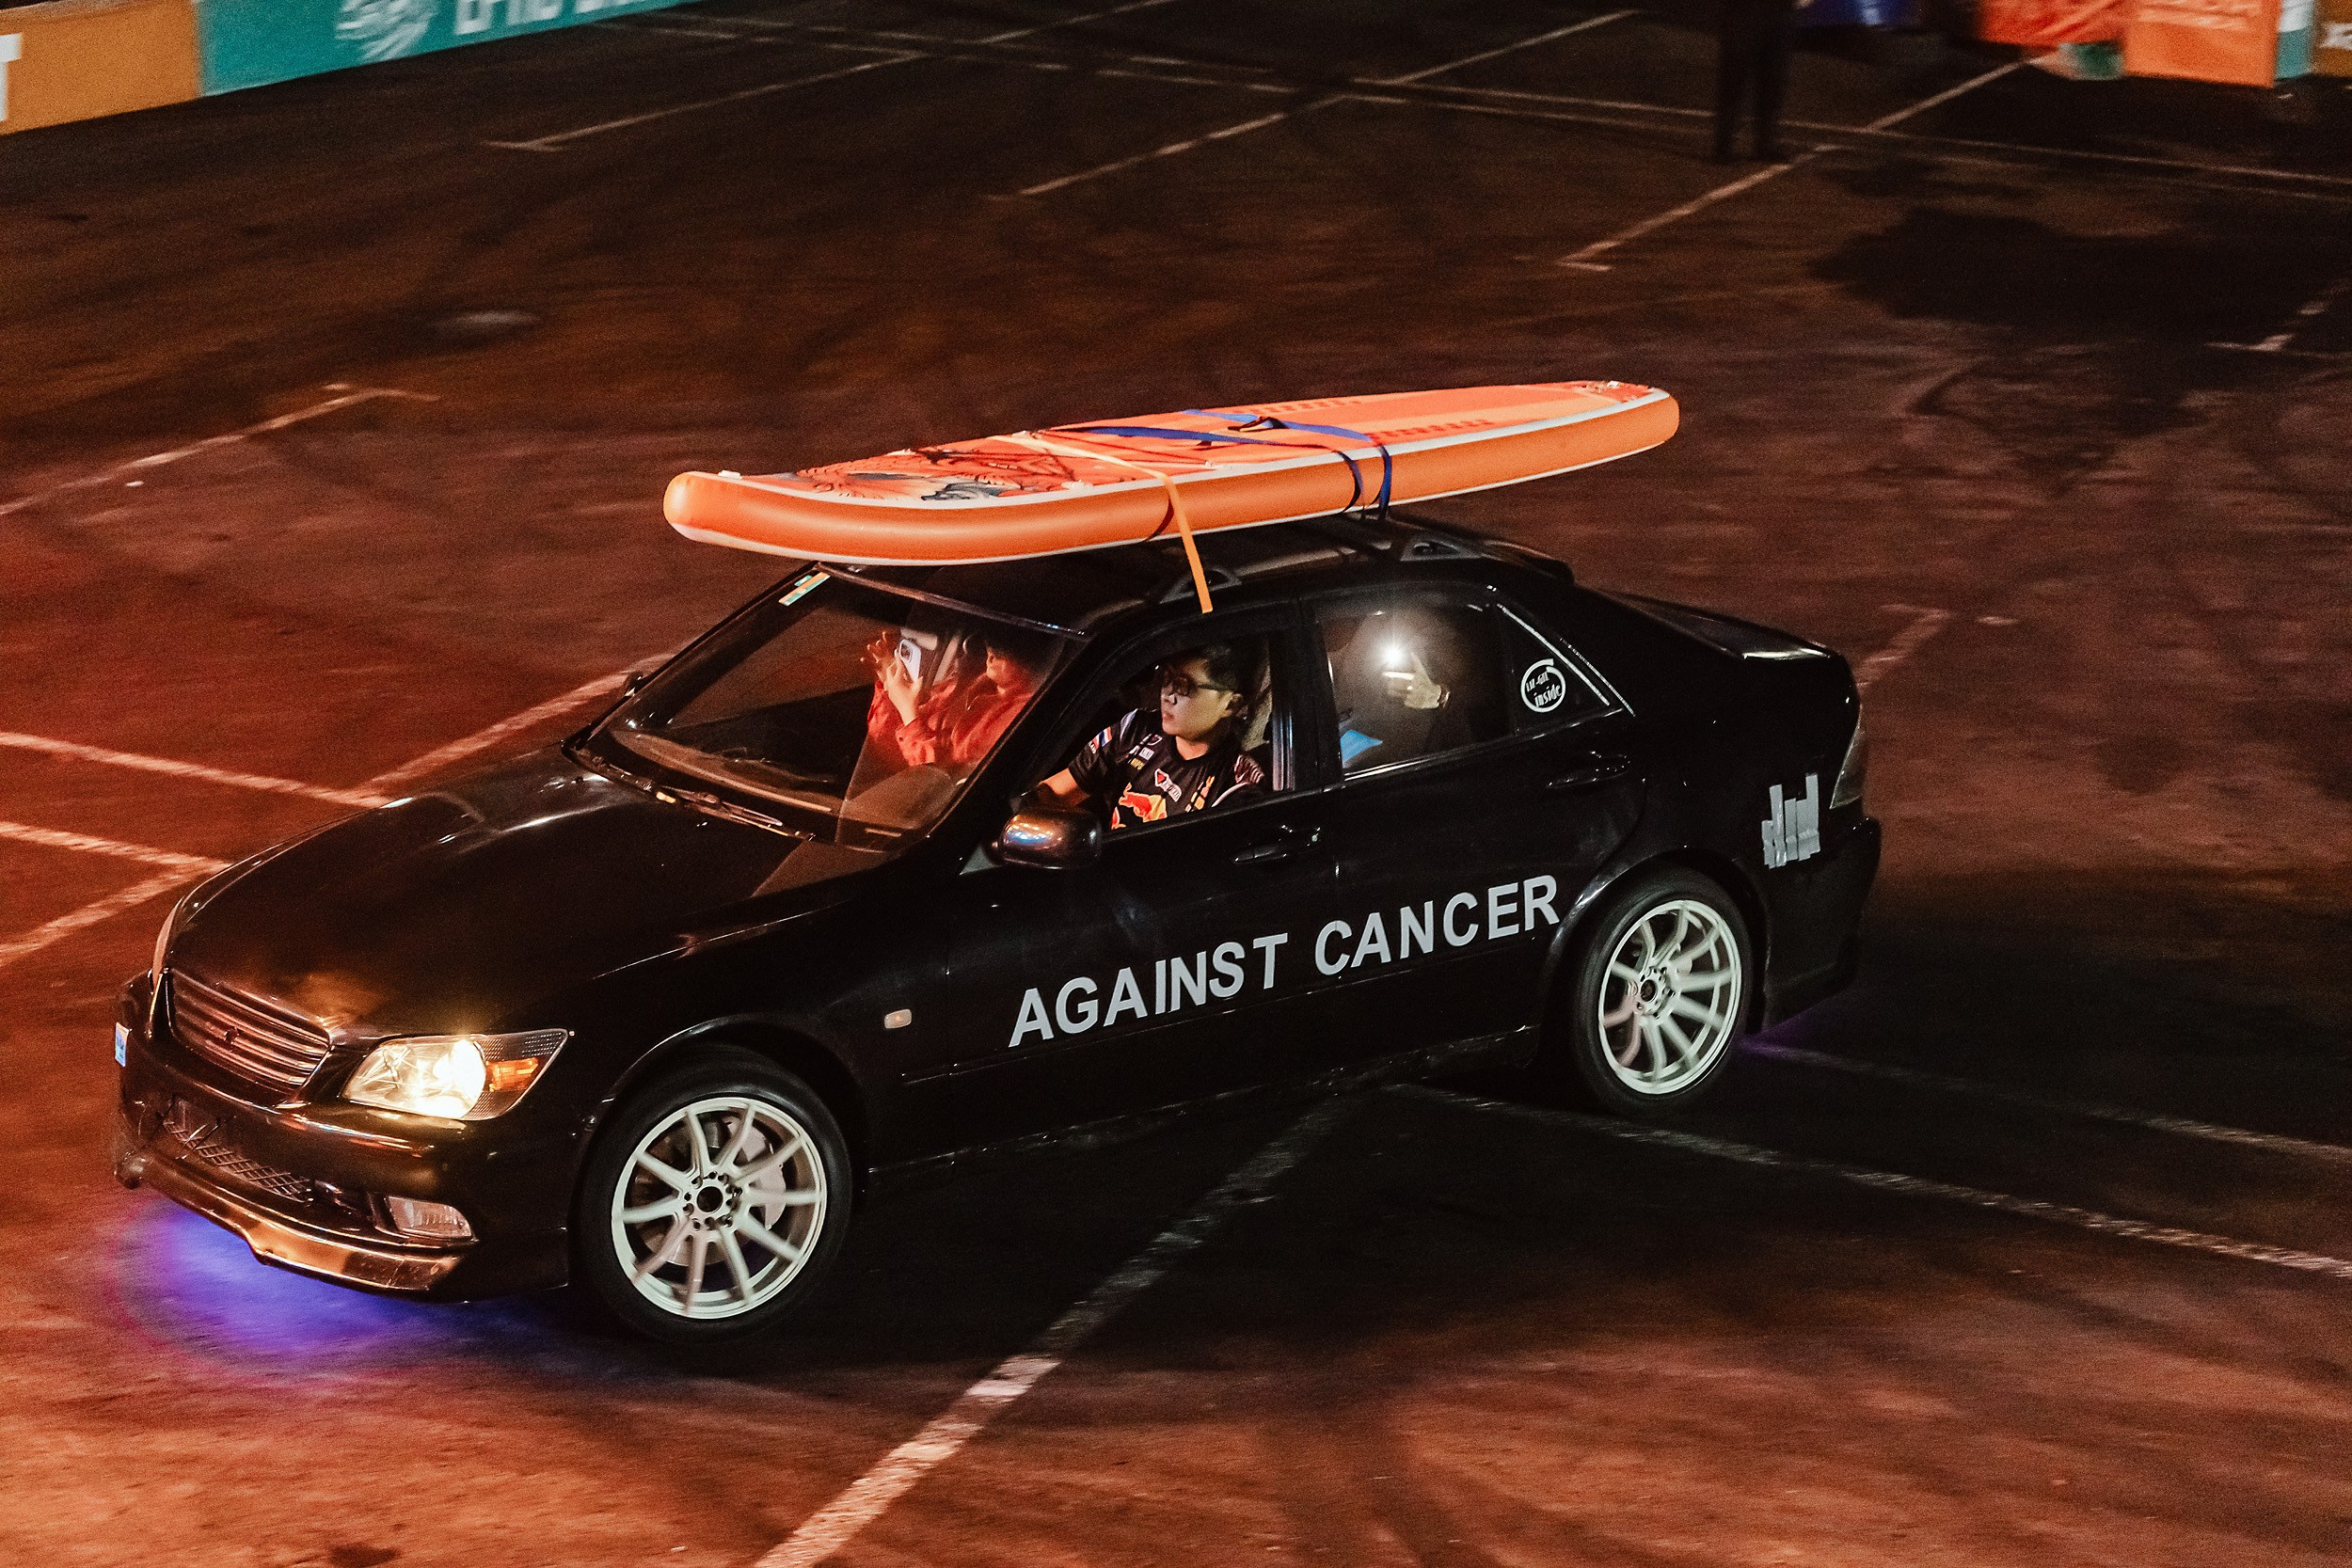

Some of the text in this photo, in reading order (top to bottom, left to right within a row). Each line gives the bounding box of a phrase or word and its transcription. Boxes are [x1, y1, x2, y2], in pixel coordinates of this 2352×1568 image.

[1534, 684, 1562, 707] inside
[1009, 875, 1560, 1047] AGAINST CANCER
